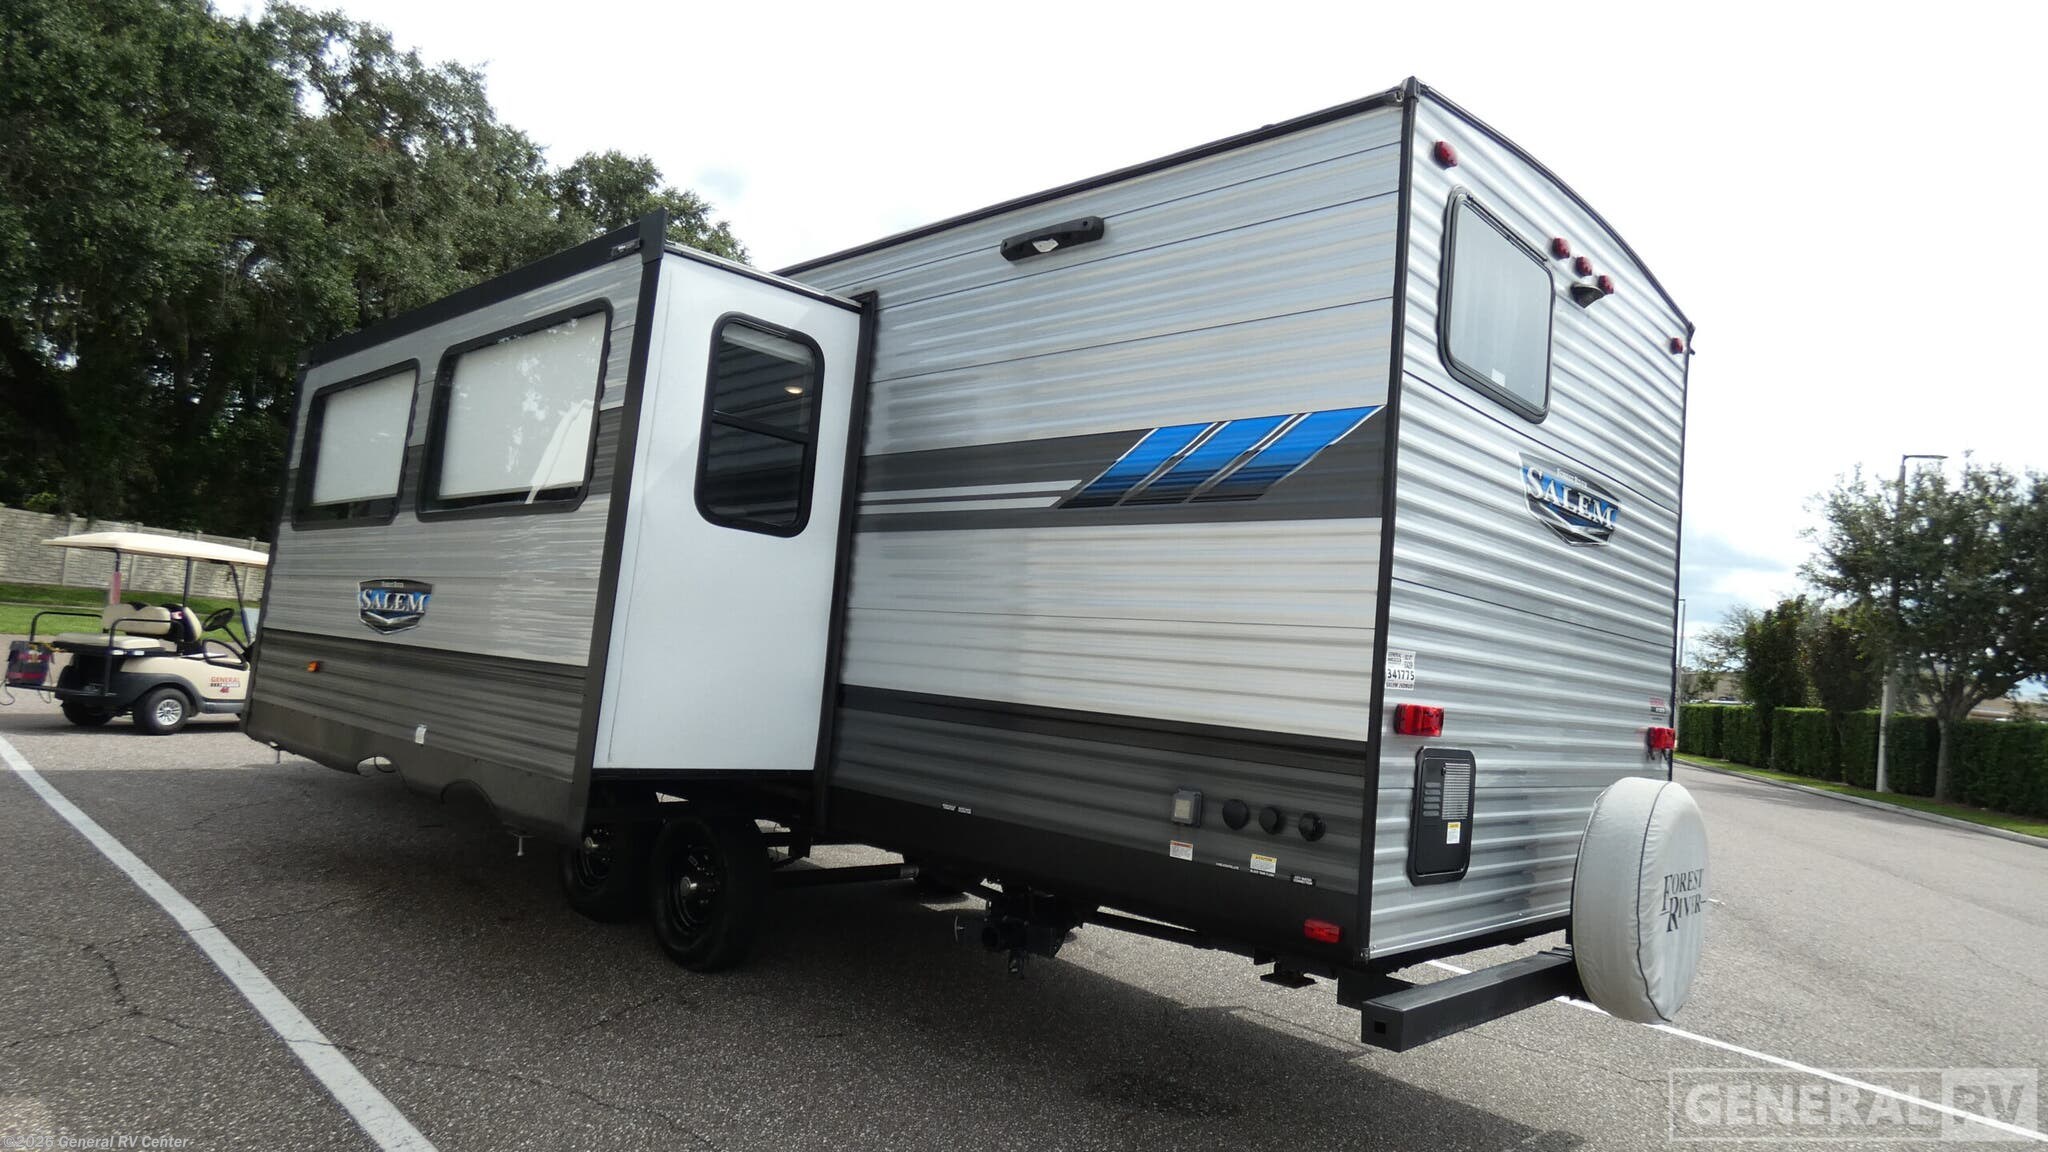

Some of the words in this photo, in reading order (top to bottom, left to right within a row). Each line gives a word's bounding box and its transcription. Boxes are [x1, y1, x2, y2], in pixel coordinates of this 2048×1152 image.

[1527, 466, 1615, 530] SALEM
[362, 588, 427, 613] SALEM
[1387, 668, 1415, 681] 341775
[1661, 868, 1704, 911] FOREST
